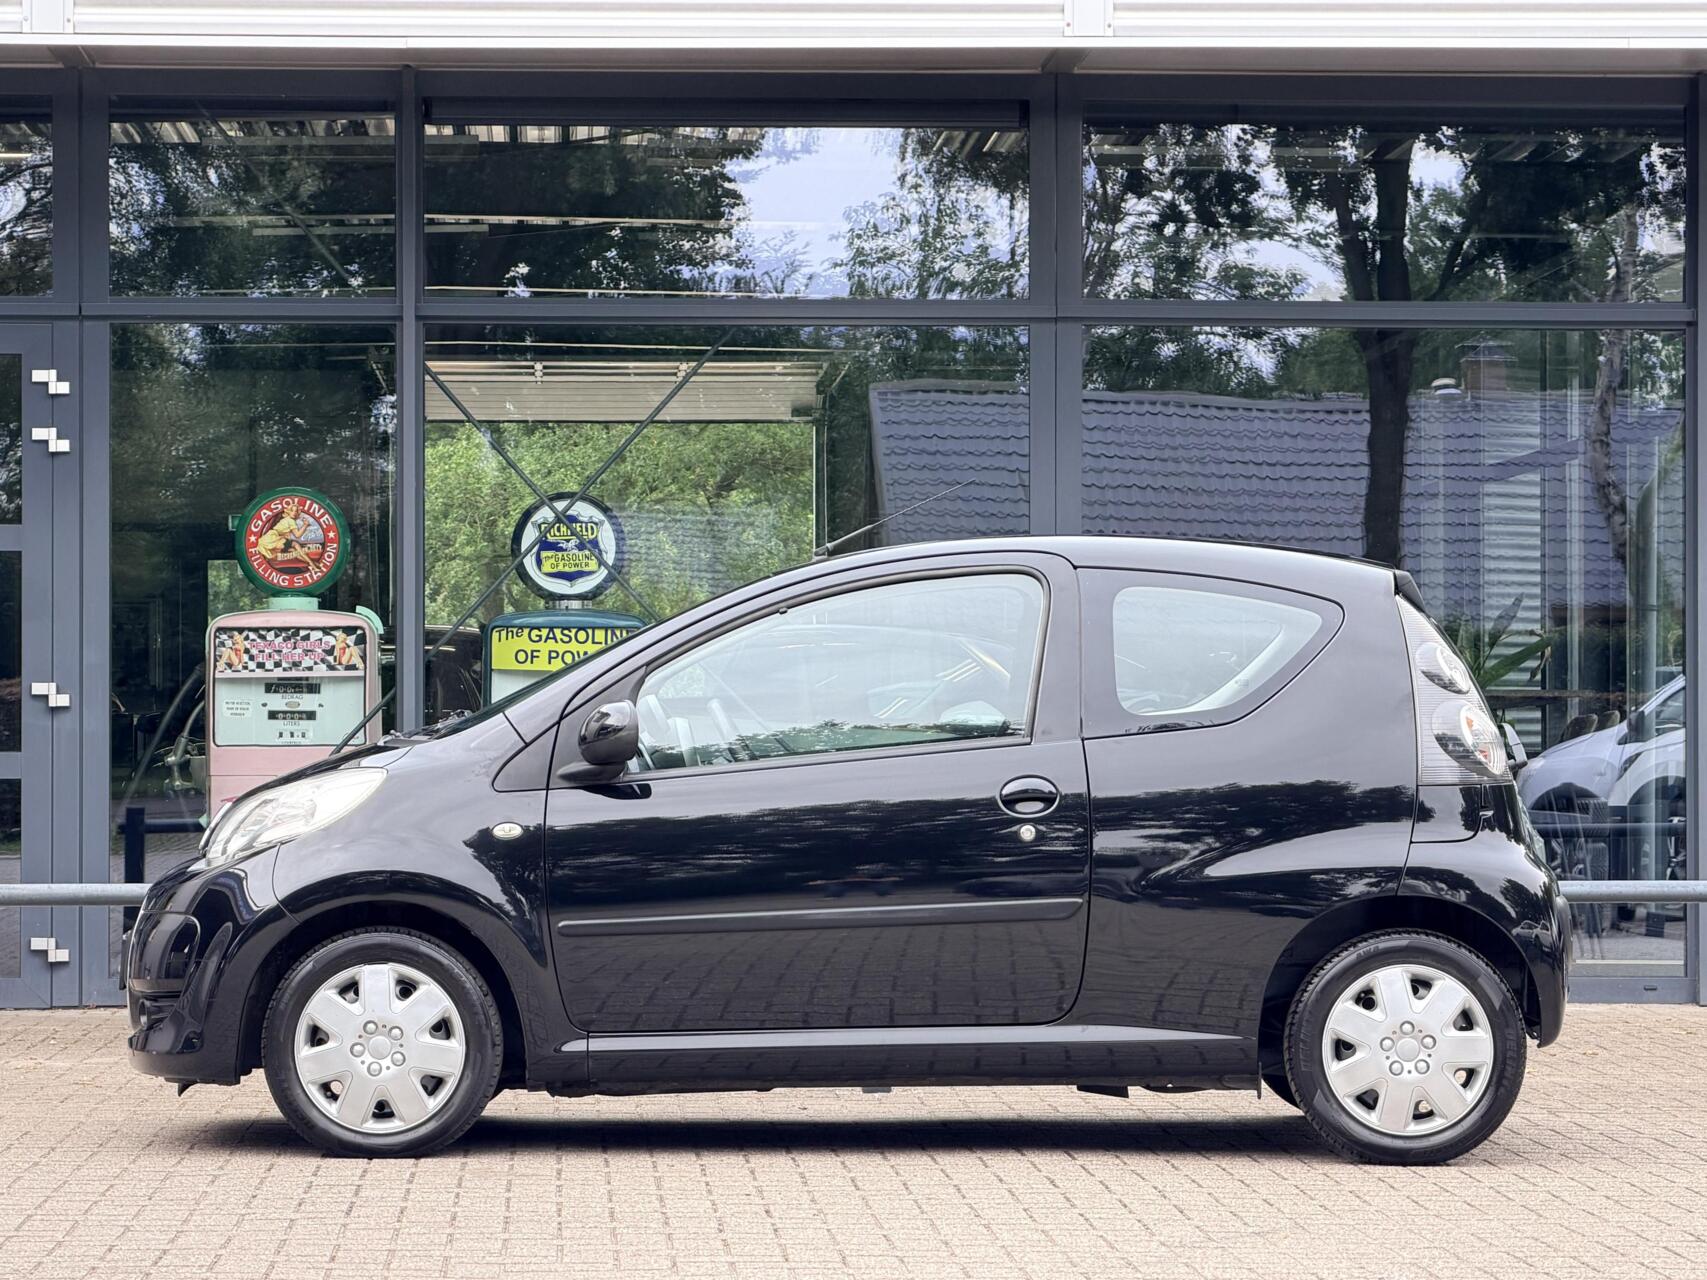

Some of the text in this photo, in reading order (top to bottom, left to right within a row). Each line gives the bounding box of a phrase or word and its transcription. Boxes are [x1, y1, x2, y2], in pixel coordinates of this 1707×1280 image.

[250, 498, 333, 532] GASOLINE
[249, 543, 337, 586] FILLING STATION
[555, 552, 595, 562] GASOLINE
[495, 627, 524, 643] The
[248, 640, 331, 650] TEXACO GIRLS
[254, 653, 279, 662] FILL
[308, 652, 325, 661] UP
[514, 649, 541, 665] OF
